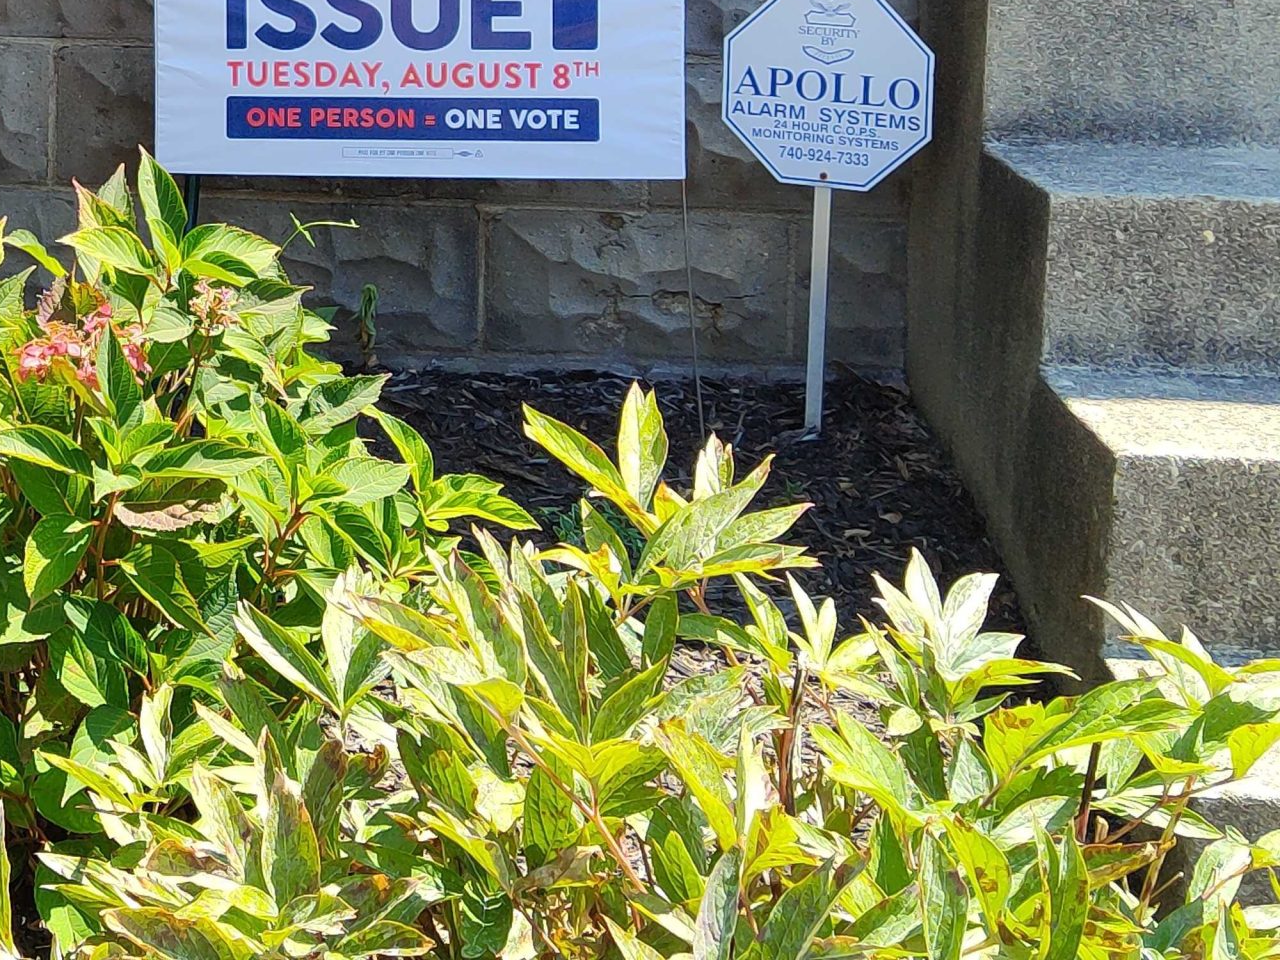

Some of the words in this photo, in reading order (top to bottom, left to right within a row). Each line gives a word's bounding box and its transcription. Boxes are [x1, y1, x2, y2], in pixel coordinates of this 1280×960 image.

[798, 25, 861, 39] SECURITY
[820, 36, 837, 47] BY
[227, 61, 391, 95] TUESDAY,
[400, 62, 543, 89] AUGUST
[733, 65, 921, 111] APOLLO
[246, 107, 302, 129] ONE
[310, 107, 416, 130] PERSON
[424, 114, 437, 128] =
[445, 108, 503, 130] ONE
[509, 109, 581, 131] VOTE
[732, 100, 806, 121] ALARM
[819, 107, 921, 132] SYSTEMS
[773, 119, 788, 130] 24
[792, 120, 829, 133] HOUR
[752, 127, 835, 146] MONITORING
[838, 136, 899, 152] SYSTEMS
[778, 145, 870, 168] 740-924-7333
